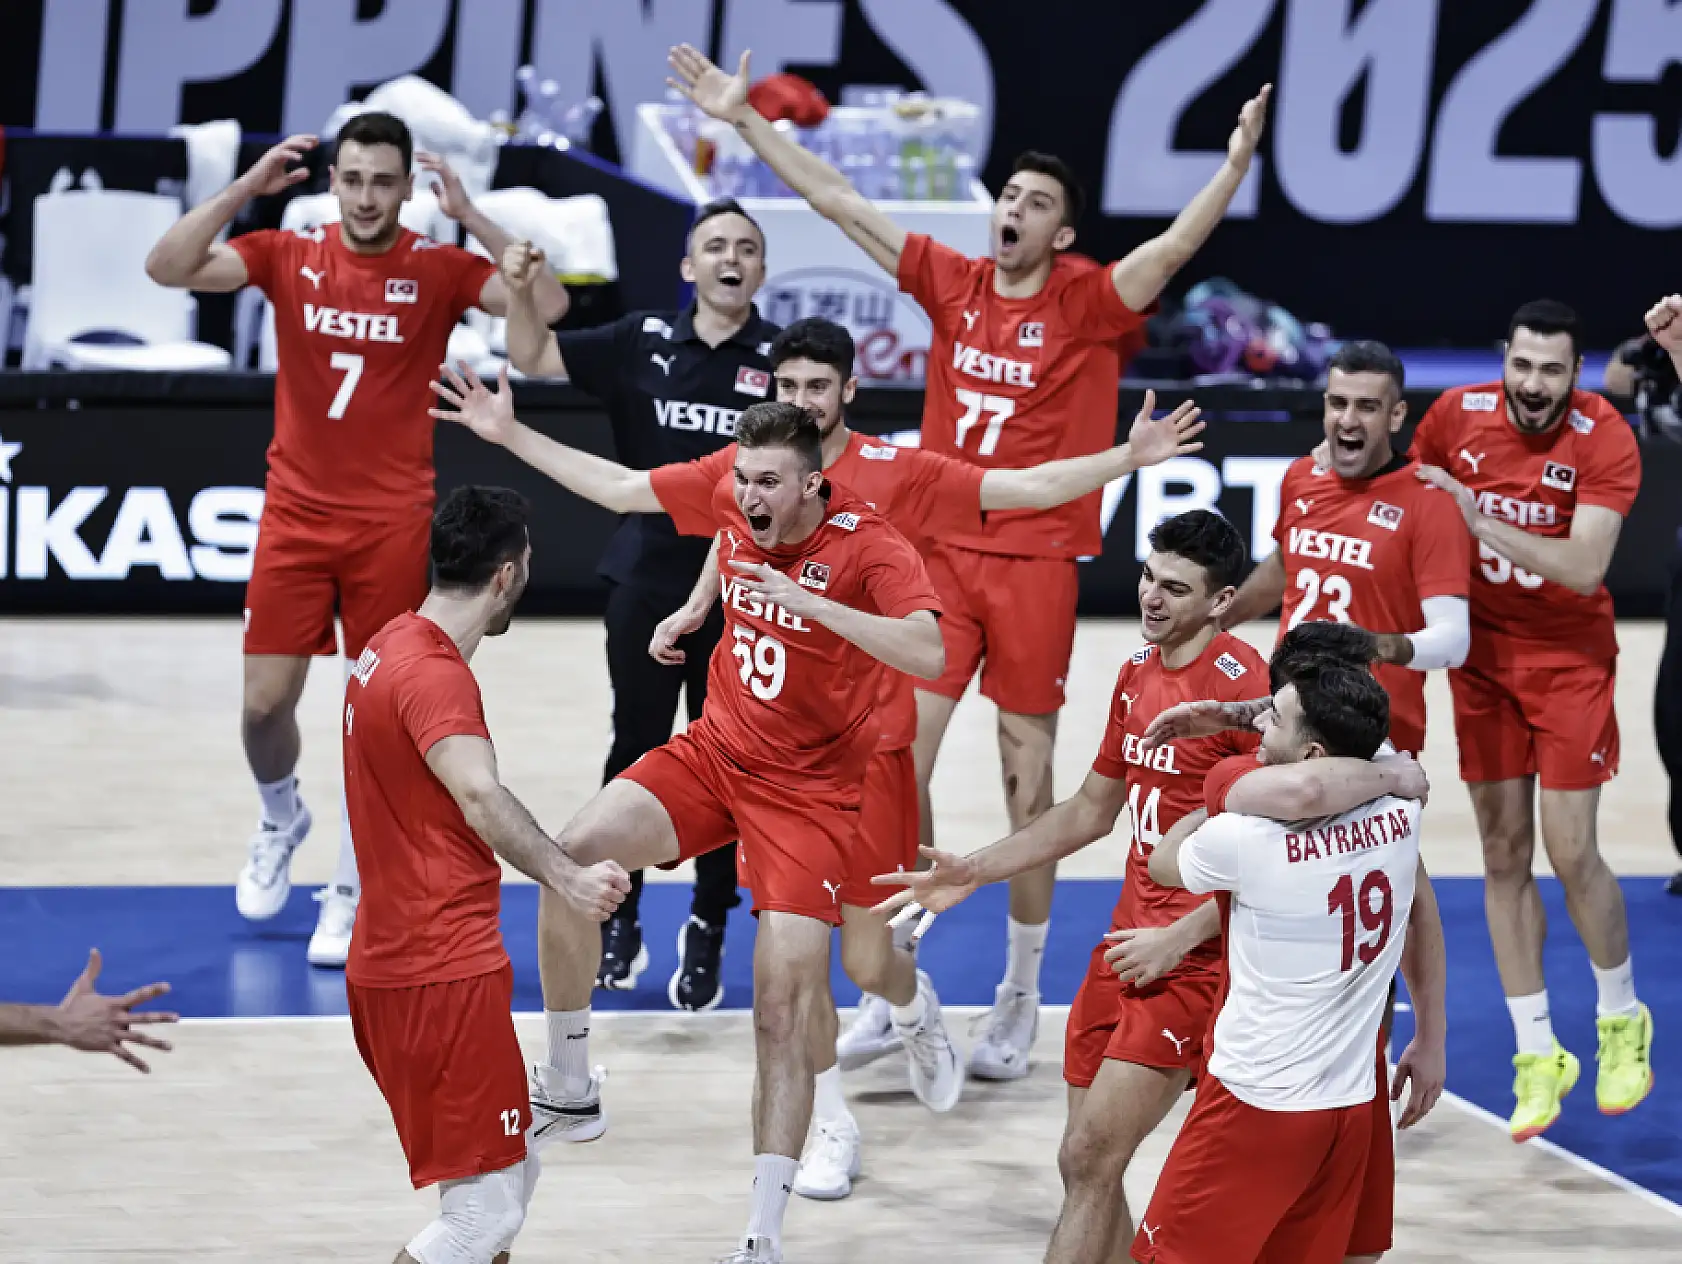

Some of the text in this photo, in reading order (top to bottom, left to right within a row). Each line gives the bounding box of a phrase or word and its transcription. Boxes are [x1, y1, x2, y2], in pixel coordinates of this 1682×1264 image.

[303, 303, 405, 344] VESTEL
[327, 351, 365, 420] 7
[953, 341, 1037, 389] VESTEL
[954, 387, 1016, 456] 77
[0, 486, 266, 582] KAS
[1288, 526, 1375, 570] VESTEL
[1288, 568, 1352, 631] 23
[732, 624, 786, 700] 59
[1129, 782, 1164, 856] 14
[1285, 808, 1412, 863] BAYRAKTAR
[1327, 869, 1393, 972] 19
[500, 1108, 521, 1136] 12
